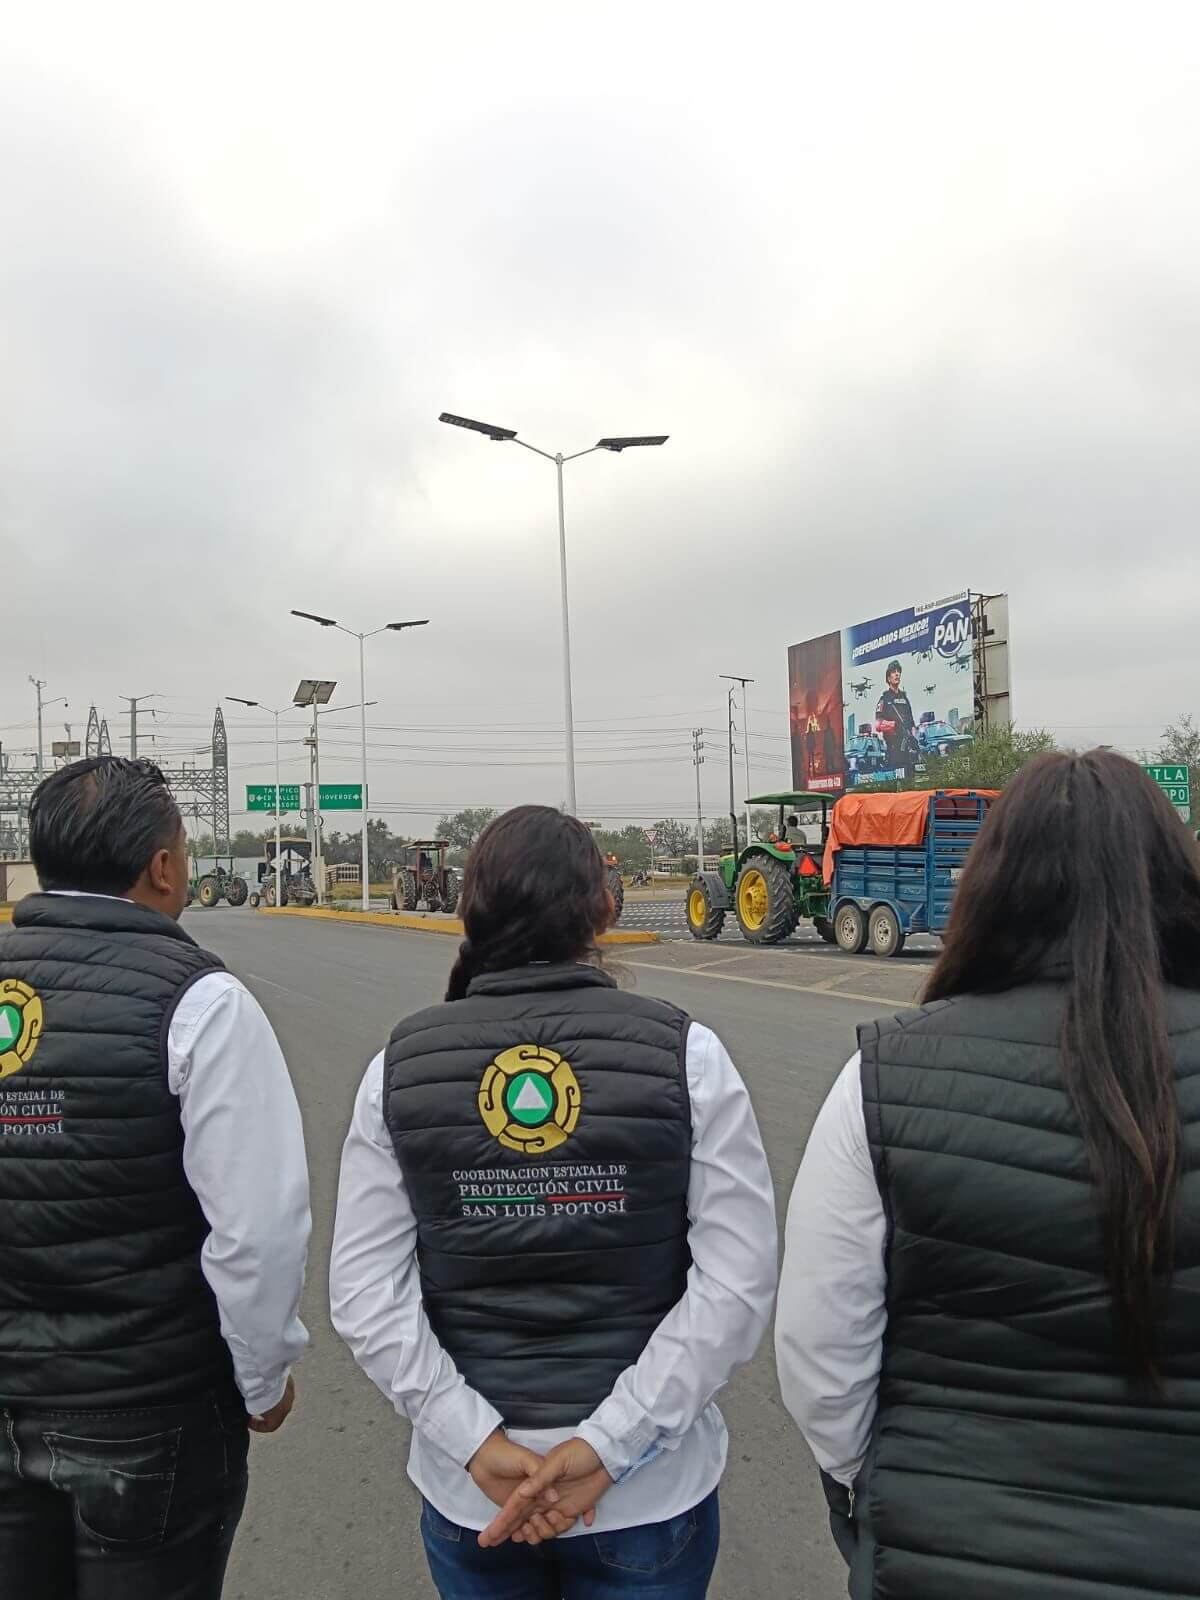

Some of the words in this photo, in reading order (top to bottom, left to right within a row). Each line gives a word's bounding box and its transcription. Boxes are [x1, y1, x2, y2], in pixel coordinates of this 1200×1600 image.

[934, 616, 969, 649] PAN
[6, 1090, 46, 1101] ESTATAL
[50, 1089, 65, 1100] DE
[21, 1103, 62, 1116] CIVIL
[3, 1120, 64, 1135] POTOSÍ
[553, 1165, 607, 1177] ESTATAL
[609, 1164, 627, 1176] DE
[458, 1179, 569, 1196] PROTECCIÓN
[574, 1179, 624, 1193] CIVIL
[462, 1204, 497, 1216] SAN
[503, 1203, 546, 1217] LUIS
[551, 1198, 626, 1216] POTOSÍ
